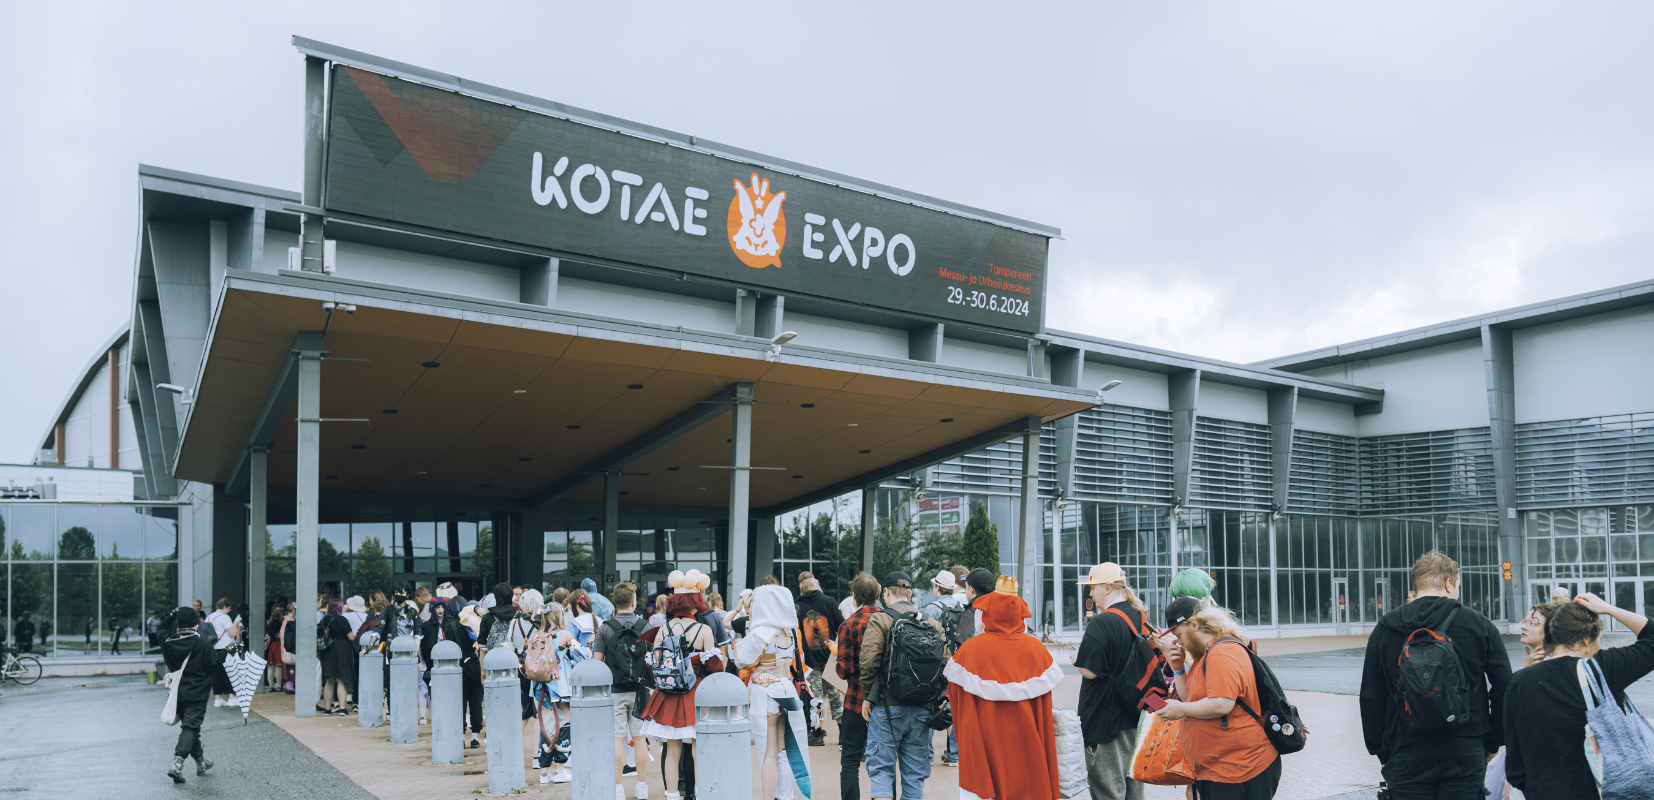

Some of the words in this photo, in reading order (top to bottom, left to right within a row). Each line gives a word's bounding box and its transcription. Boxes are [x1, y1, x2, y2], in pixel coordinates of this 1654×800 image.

[531, 151, 710, 236] KOTAE
[802, 212, 916, 276] EXPO
[939, 267, 968, 281] Messu-
[969, 273, 977, 285] ja
[978, 275, 1031, 295] Urheilukeskus
[989, 263, 1032, 281] Tampereen
[947, 286, 1030, 317] 29.-30.6.2024
